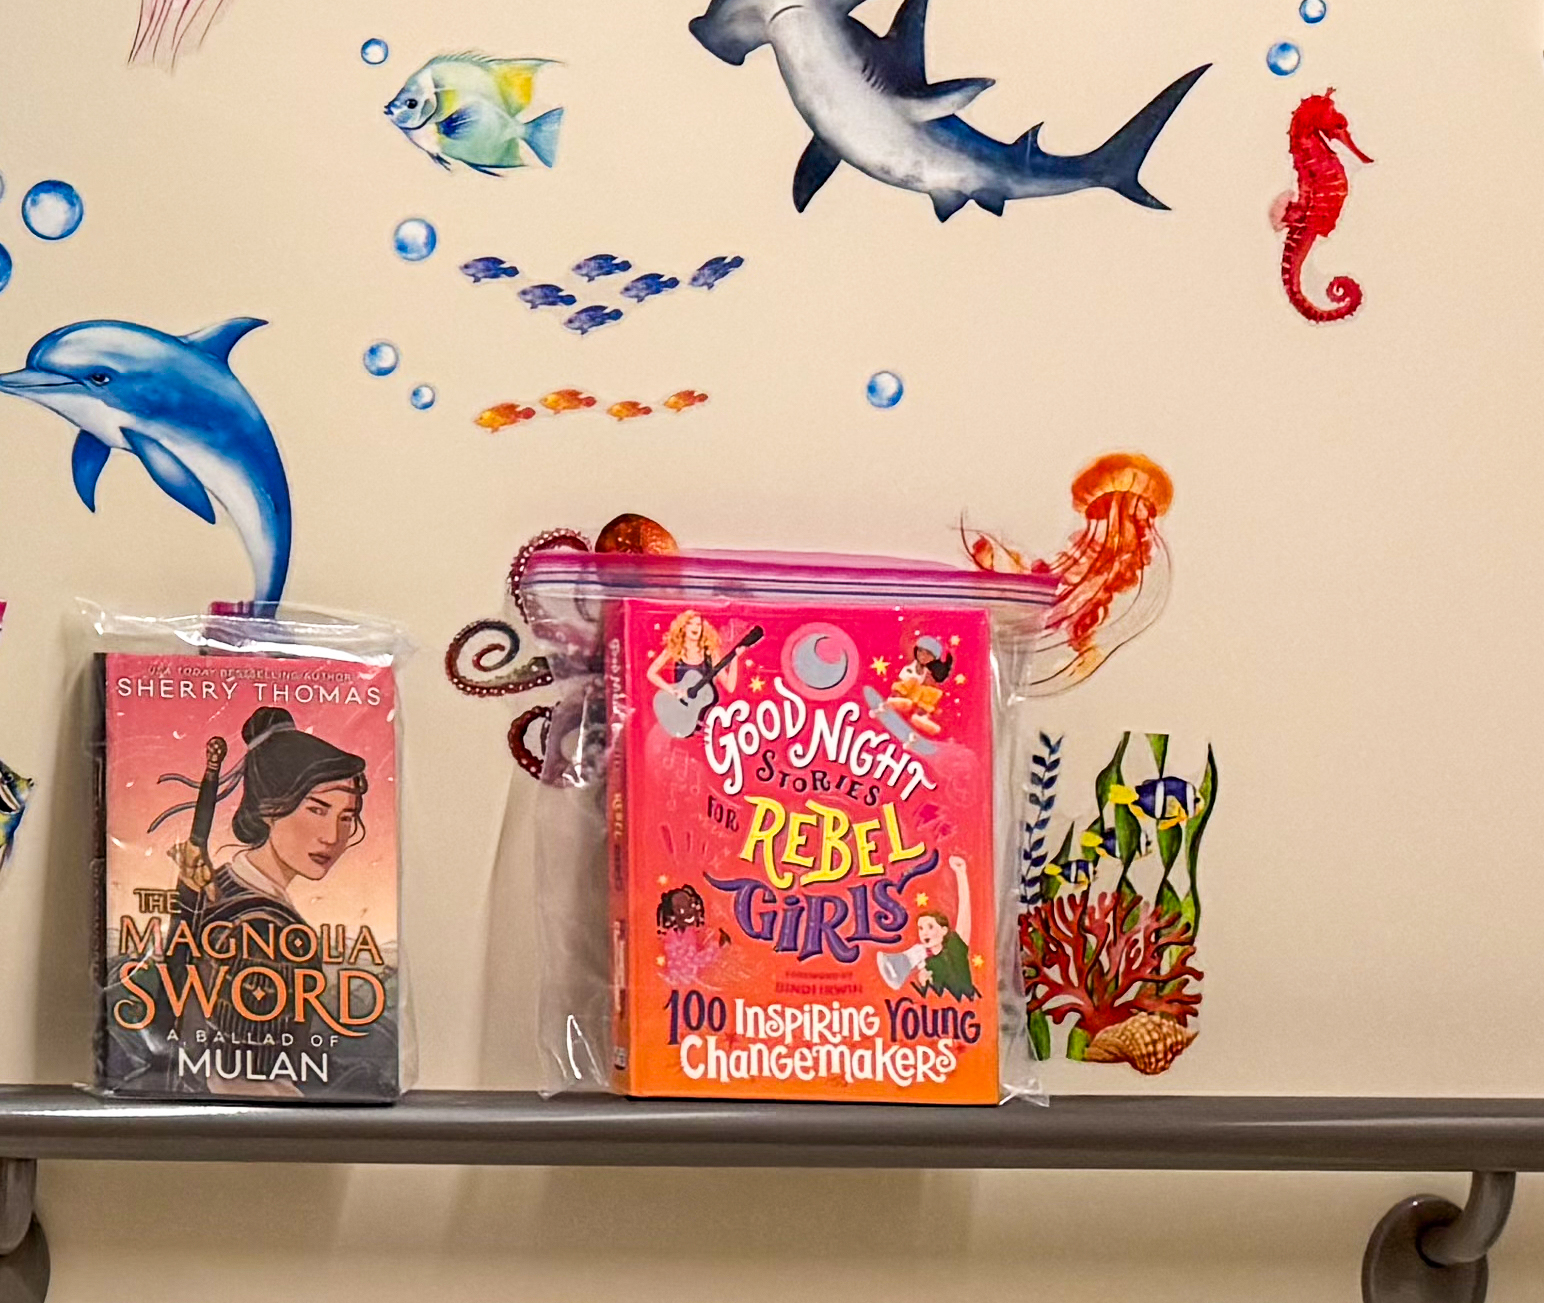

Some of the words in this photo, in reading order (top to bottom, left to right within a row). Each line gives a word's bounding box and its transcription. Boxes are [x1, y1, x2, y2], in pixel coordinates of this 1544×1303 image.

[117, 676, 239, 700] SHERRY
[252, 683, 382, 707] THOMAS
[756, 749, 880, 807] STORIES
[739, 795, 926, 889] REBEL
[132, 887, 182, 915] THE
[119, 915, 385, 966] MAGNOLIA
[113, 960, 386, 1037] SWORD
[664, 989, 727, 1046] 100
[167, 1028, 180, 1041] A
[196, 1029, 295, 1047] BALLAD
[310, 1034, 340, 1047] OF
[178, 1048, 329, 1083] MULAN
